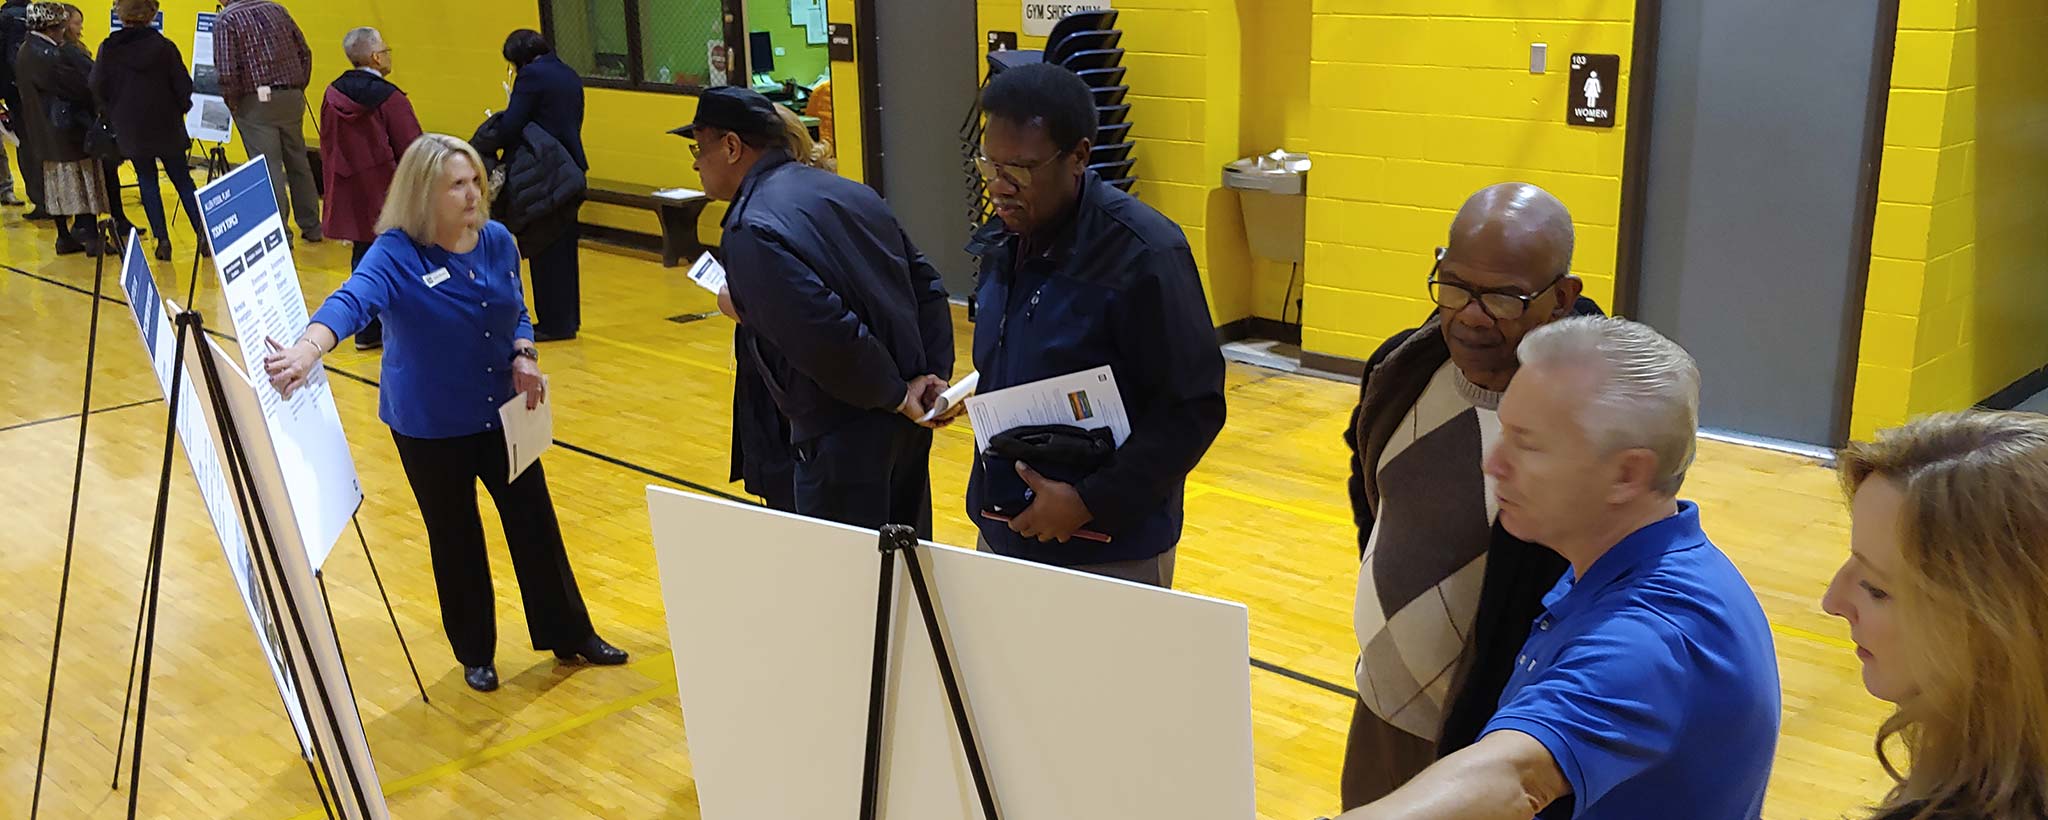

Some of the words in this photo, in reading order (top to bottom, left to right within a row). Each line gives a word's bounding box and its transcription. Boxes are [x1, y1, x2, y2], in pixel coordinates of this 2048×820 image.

[1026, 4, 1044, 19] GYM
[1046, 4, 1072, 20] SHOES
[1572, 55, 1587, 65] 103
[1574, 107, 1608, 118] WOMEN
